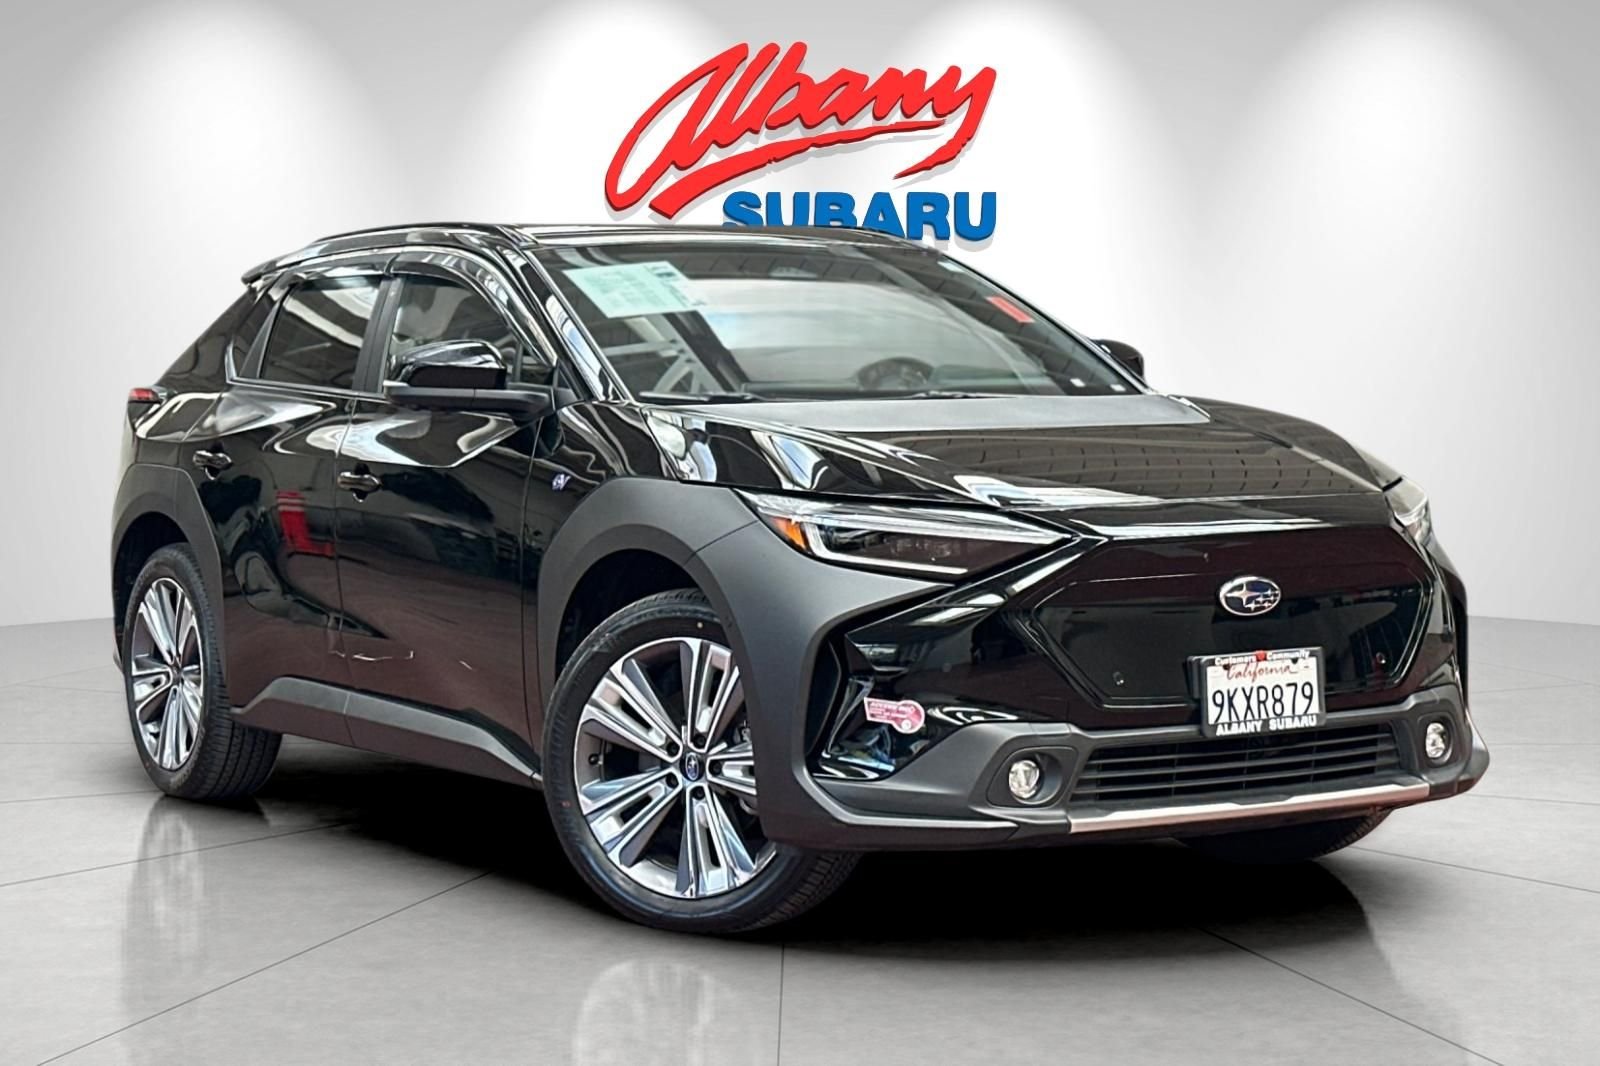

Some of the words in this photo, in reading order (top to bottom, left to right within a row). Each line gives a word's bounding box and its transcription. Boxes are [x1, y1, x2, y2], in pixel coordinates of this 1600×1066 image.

[605, 41, 997, 211] Albany
[722, 191, 997, 241] SUBARU
[1226, 662, 1299, 683] California
[1212, 681, 1314, 723] 9KXR879
[1216, 719, 1263, 736] ALBANY
[1269, 714, 1317, 731] SUBARU
